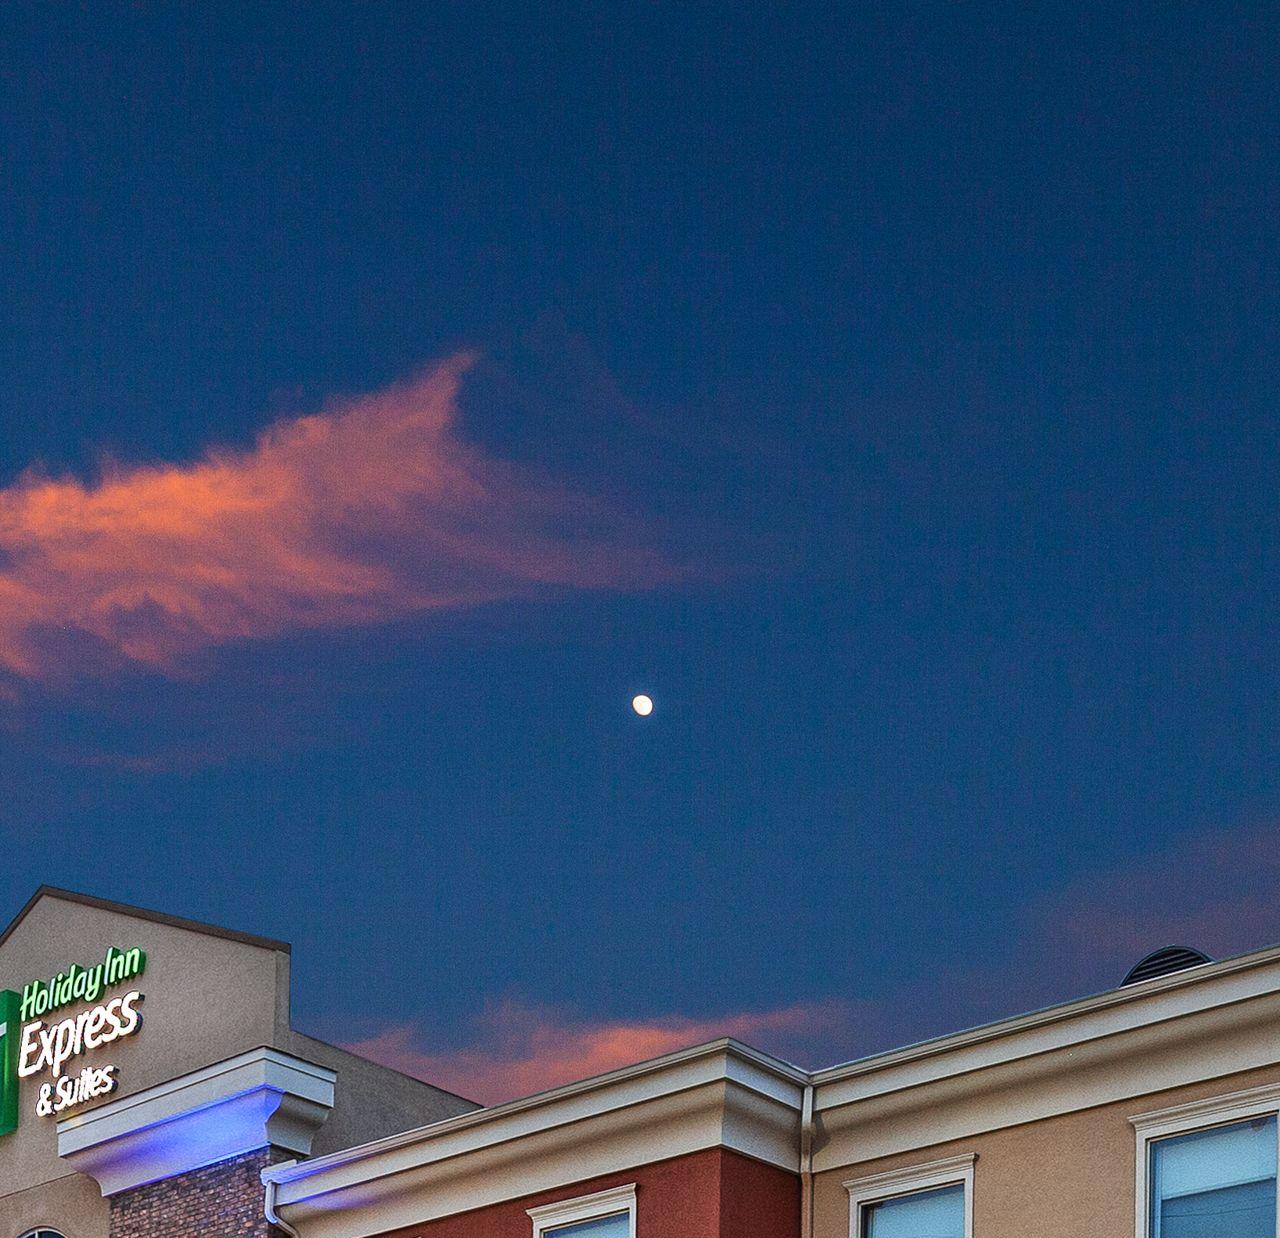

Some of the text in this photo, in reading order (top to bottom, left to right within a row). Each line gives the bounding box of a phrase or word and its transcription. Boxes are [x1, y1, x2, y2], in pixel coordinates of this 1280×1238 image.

[19, 946, 143, 1021] Holiday Inn
[18, 991, 142, 1077] Express
[36, 1065, 116, 1117] & Suites
